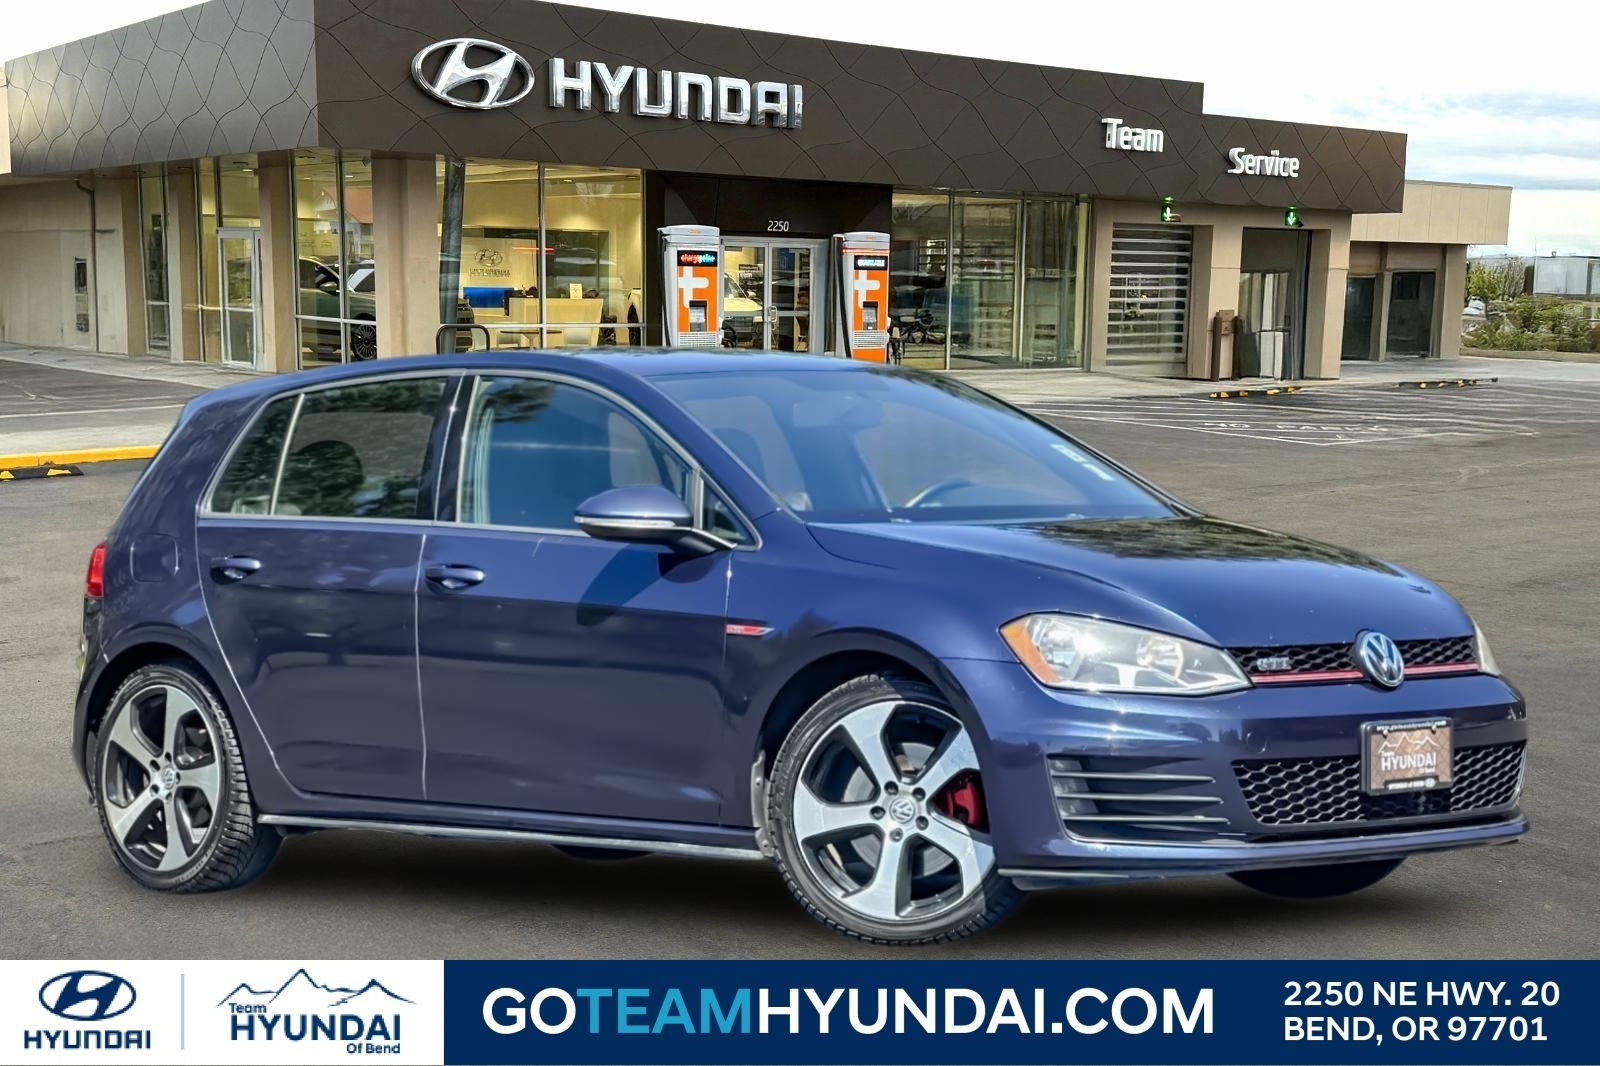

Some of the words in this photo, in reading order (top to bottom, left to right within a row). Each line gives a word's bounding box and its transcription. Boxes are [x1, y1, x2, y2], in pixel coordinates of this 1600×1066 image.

[549, 57, 804, 129] HYUNDAI
[1101, 117, 1164, 153] Team
[1227, 147, 1300, 178] Service
[767, 219, 790, 233] 2250
[1381, 752, 1437, 771] HYUNDAI
